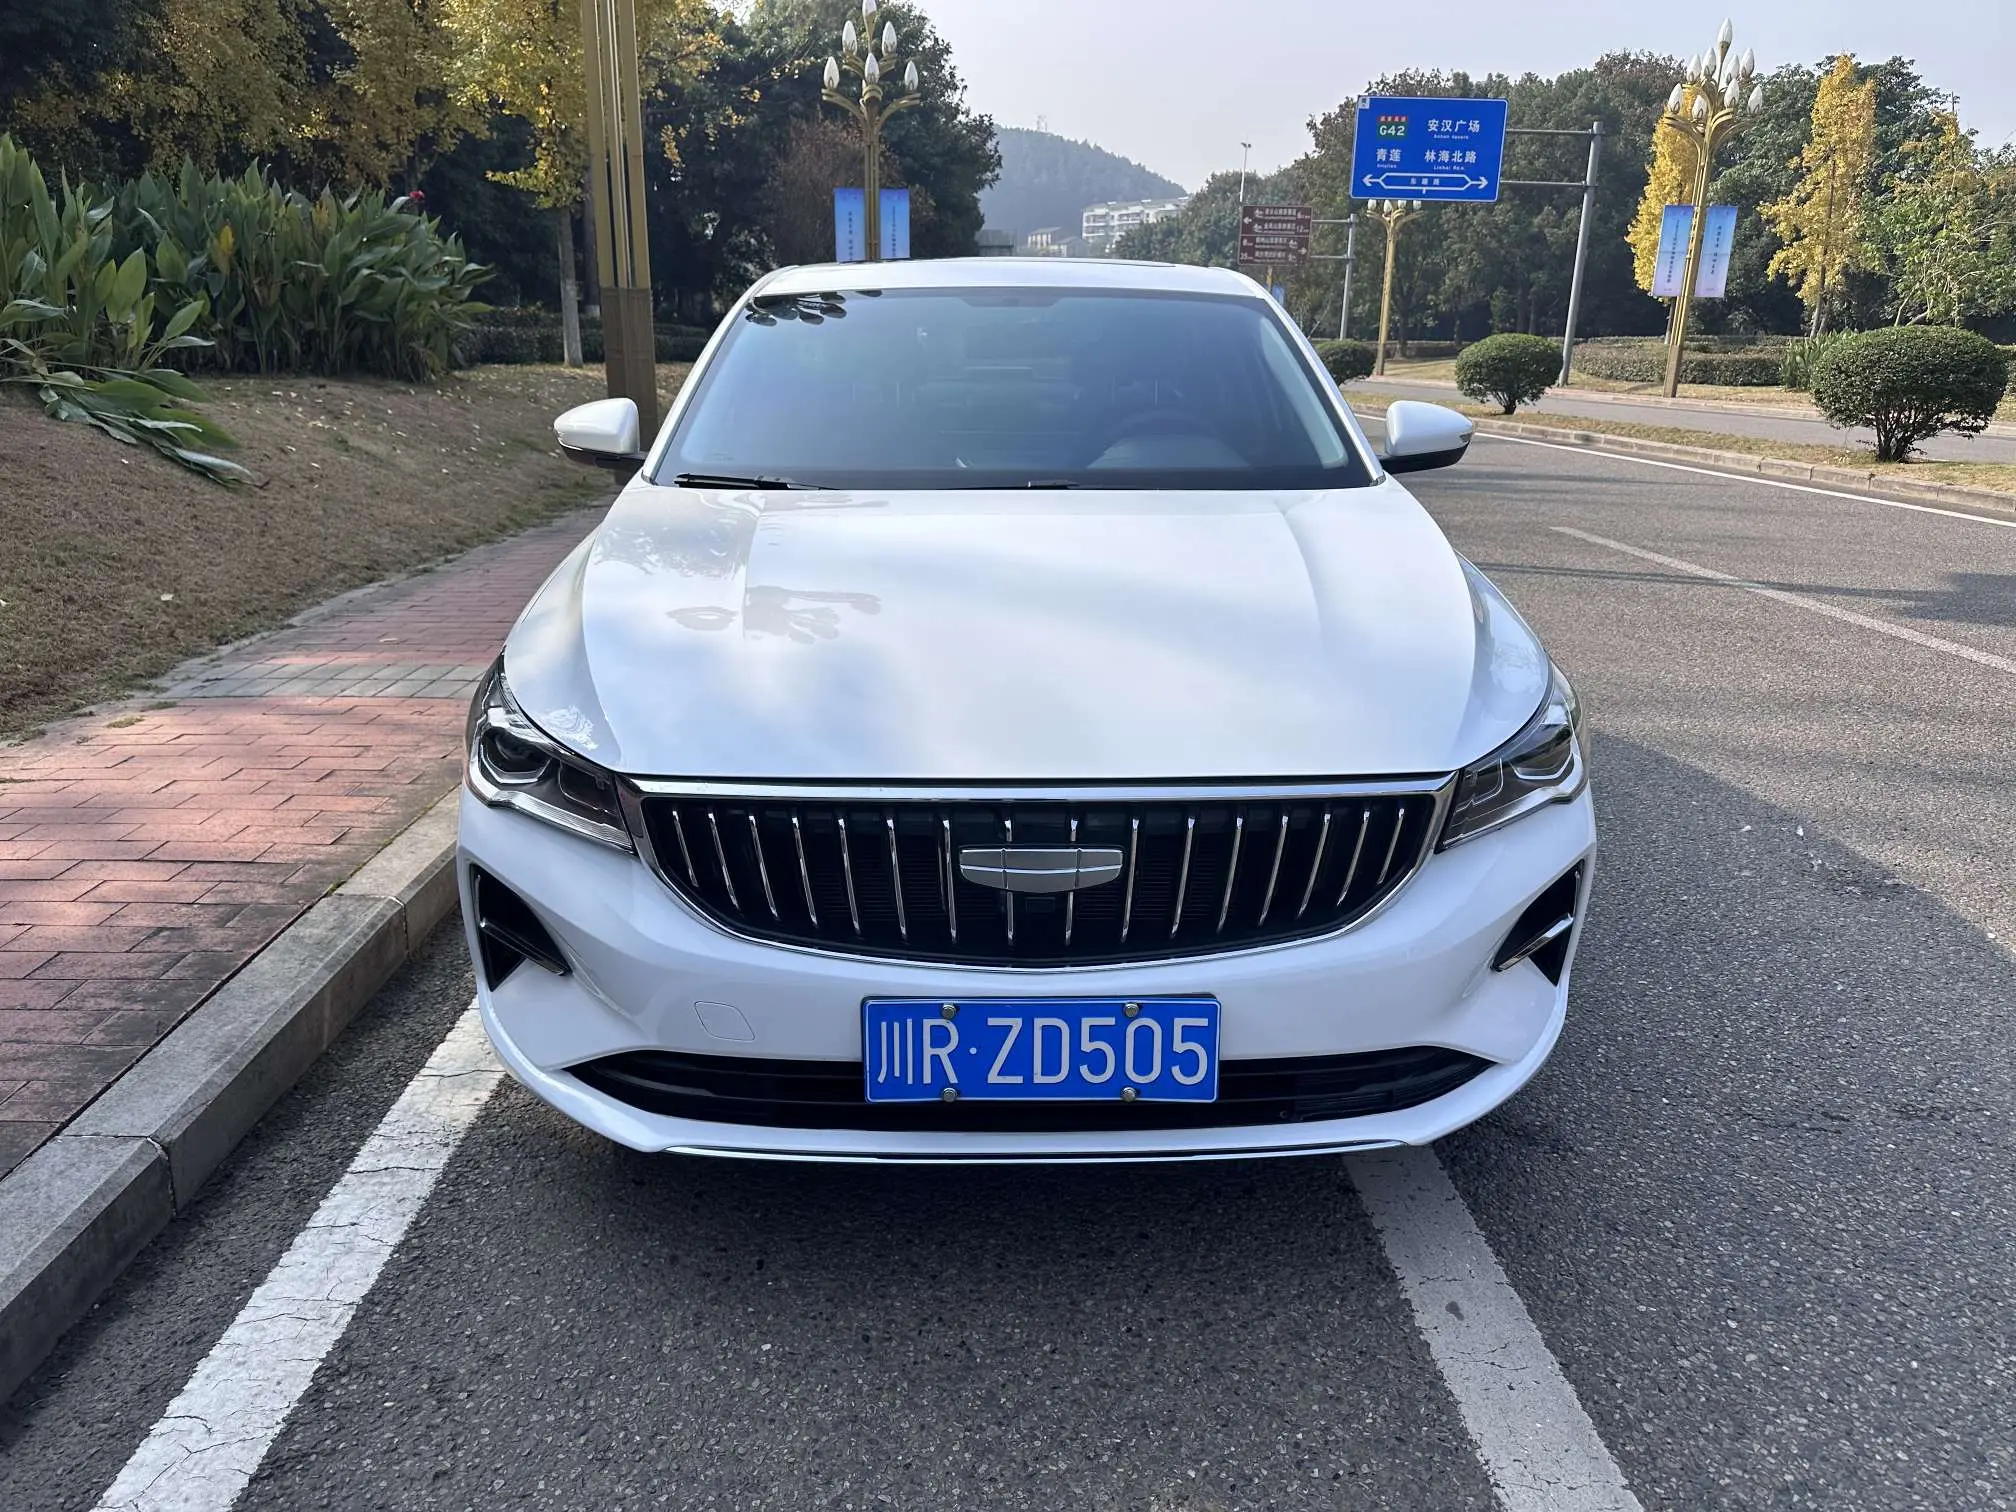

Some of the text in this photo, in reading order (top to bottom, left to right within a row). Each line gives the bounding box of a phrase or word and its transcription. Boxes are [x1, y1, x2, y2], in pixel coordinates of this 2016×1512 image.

[1379, 125, 1405, 136] G42
[1427, 118, 1480, 133] 安汉广场
[1376, 148, 1402, 162] 青莲
[1424, 149, 1477, 164] 林海北路
